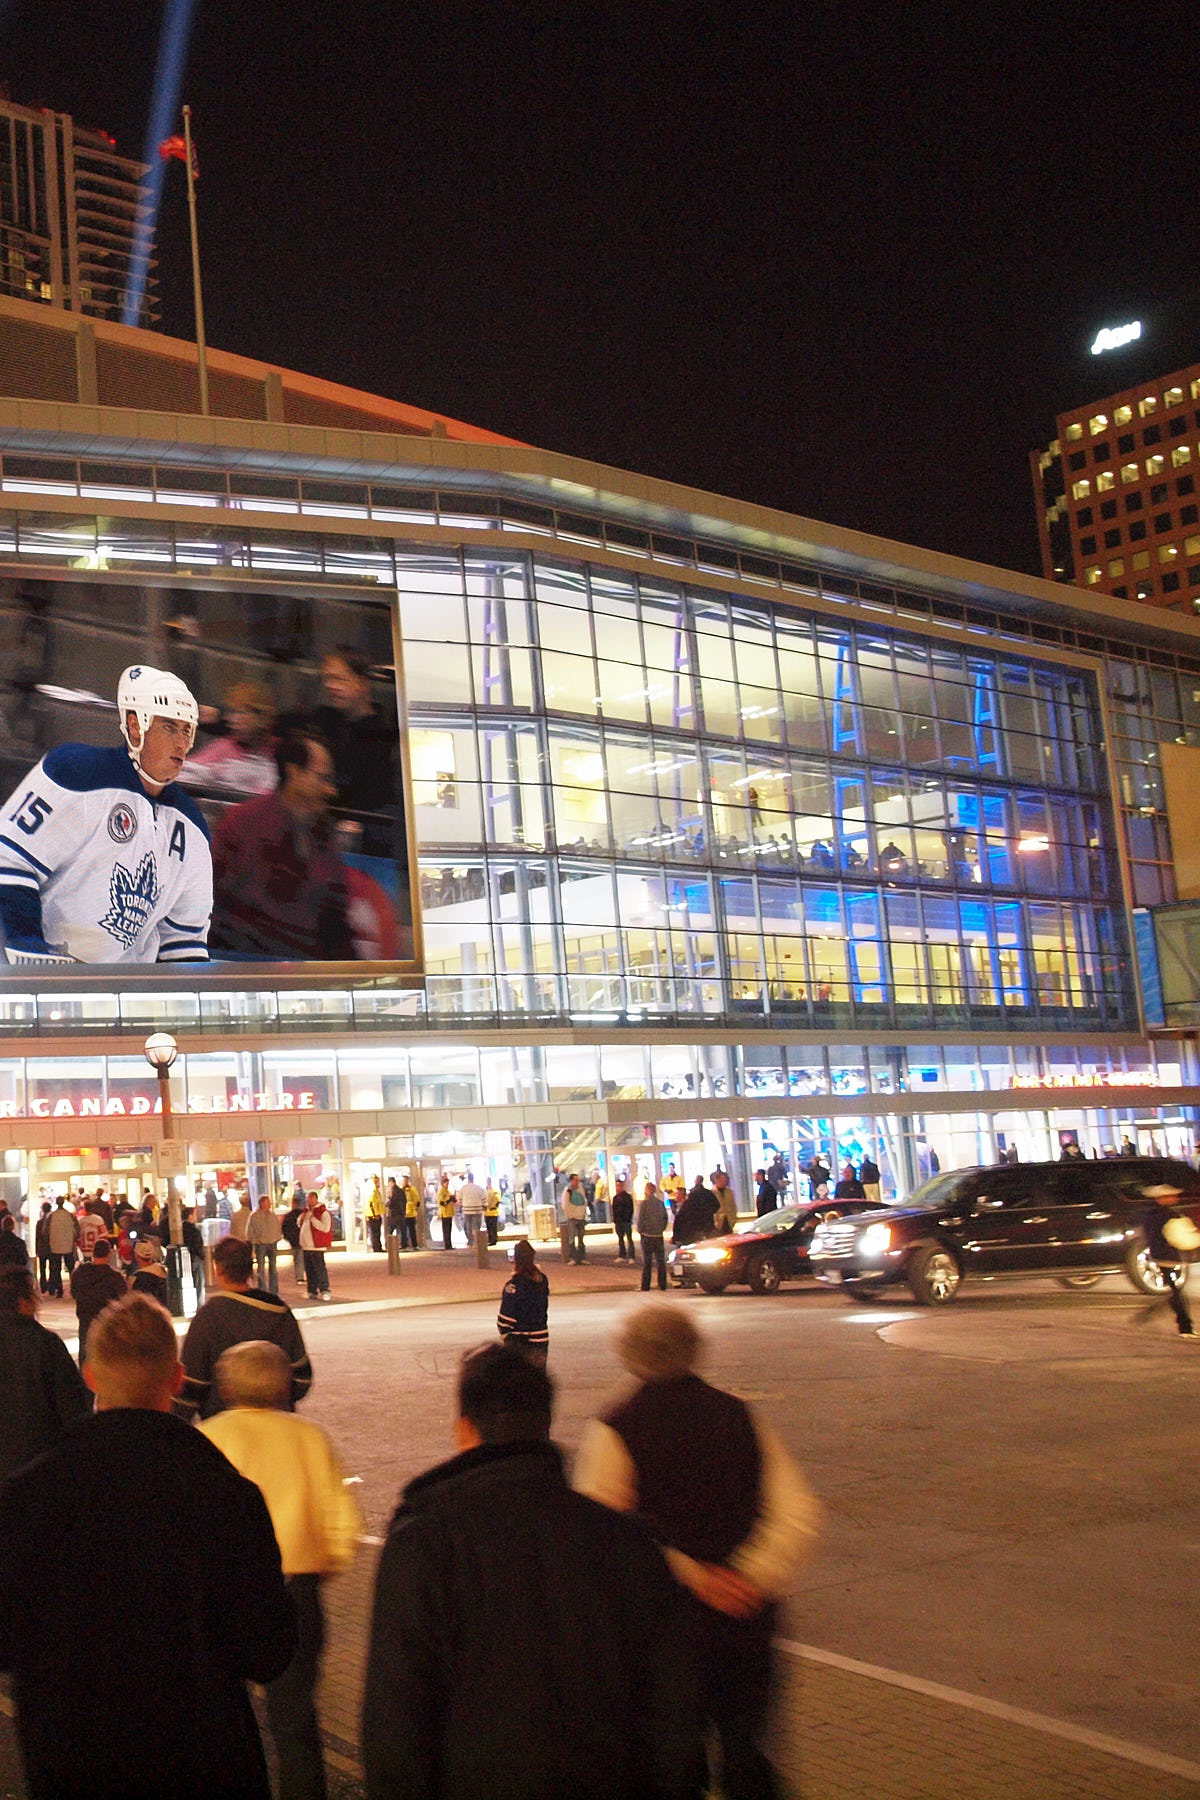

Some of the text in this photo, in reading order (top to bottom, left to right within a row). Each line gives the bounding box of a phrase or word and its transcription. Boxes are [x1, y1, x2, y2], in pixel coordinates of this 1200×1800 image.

[9, 791, 53, 835] 15
[169, 820, 185, 862] A
[117, 916, 142, 936] LEAF
